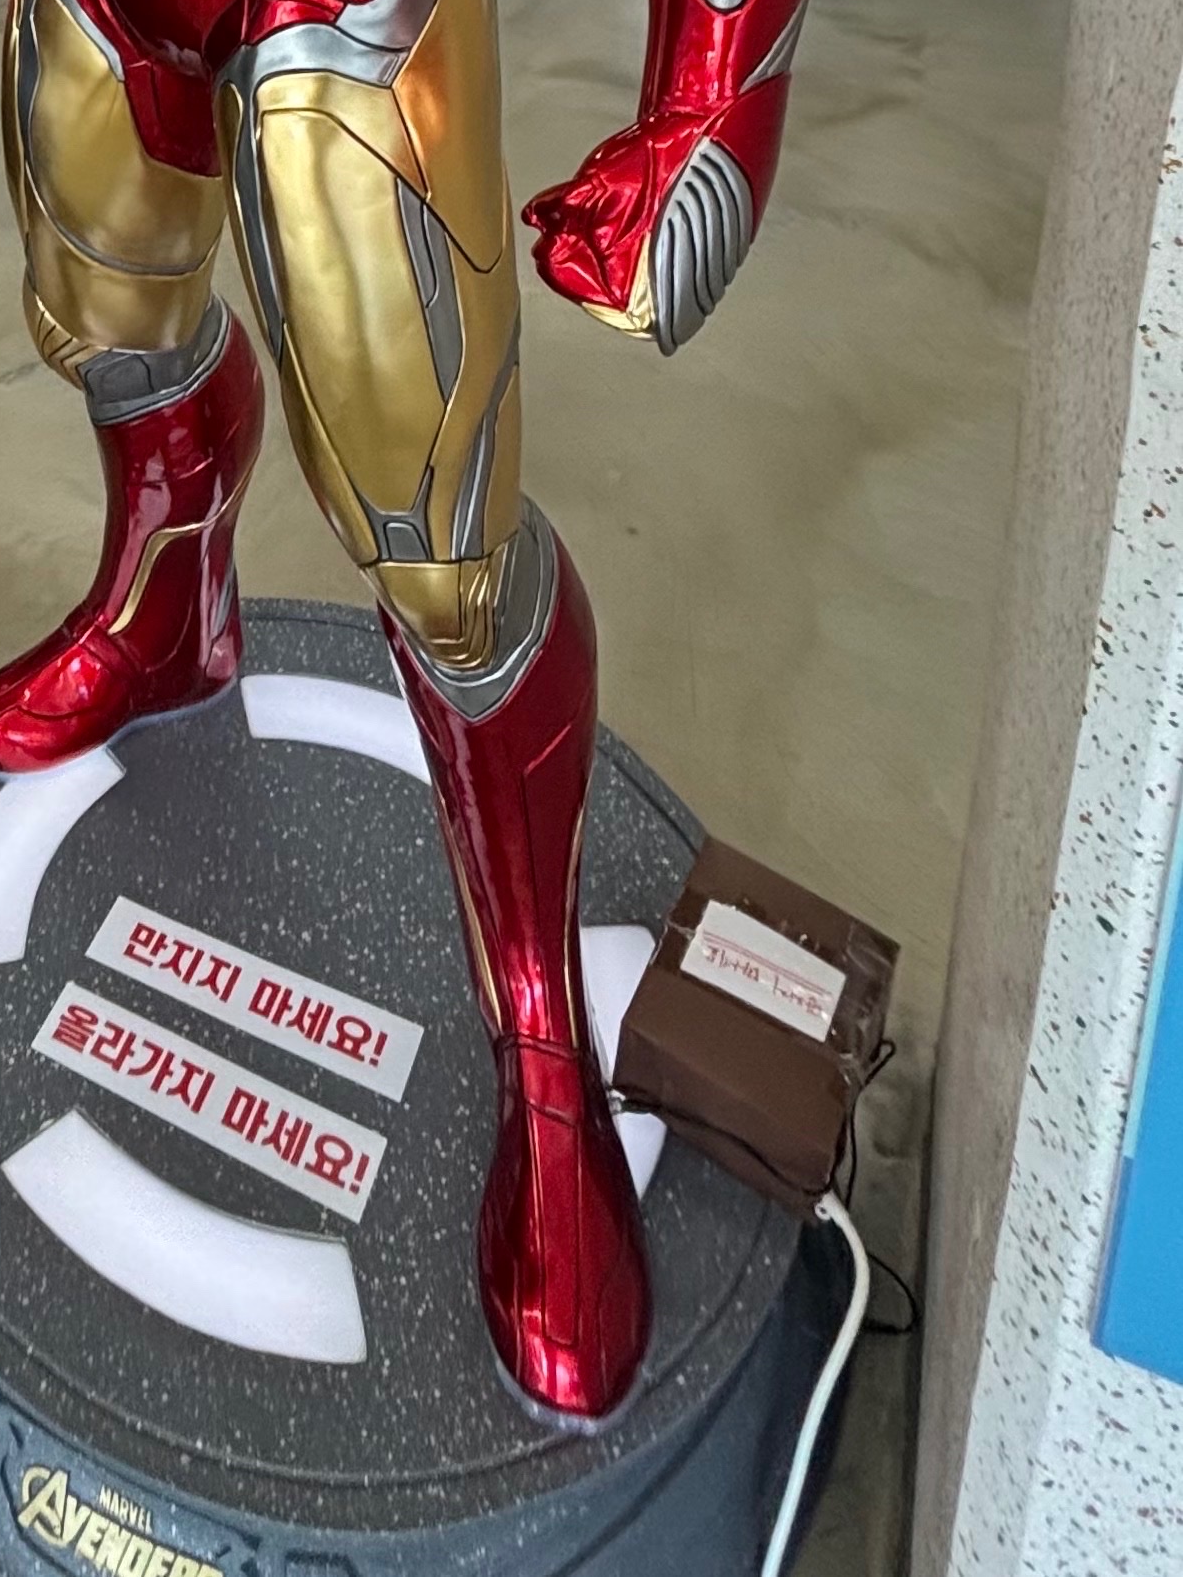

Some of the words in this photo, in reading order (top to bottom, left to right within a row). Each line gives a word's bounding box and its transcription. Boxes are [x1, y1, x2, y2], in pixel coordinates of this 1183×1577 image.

[123, 922, 242, 1003] 만지지
[248, 978, 388, 1068] 마세요!
[51, 1003, 216, 1114] 올라가지
[221, 1086, 370, 1196] 마세요!
[97, 1484, 154, 1535] MARVEL
